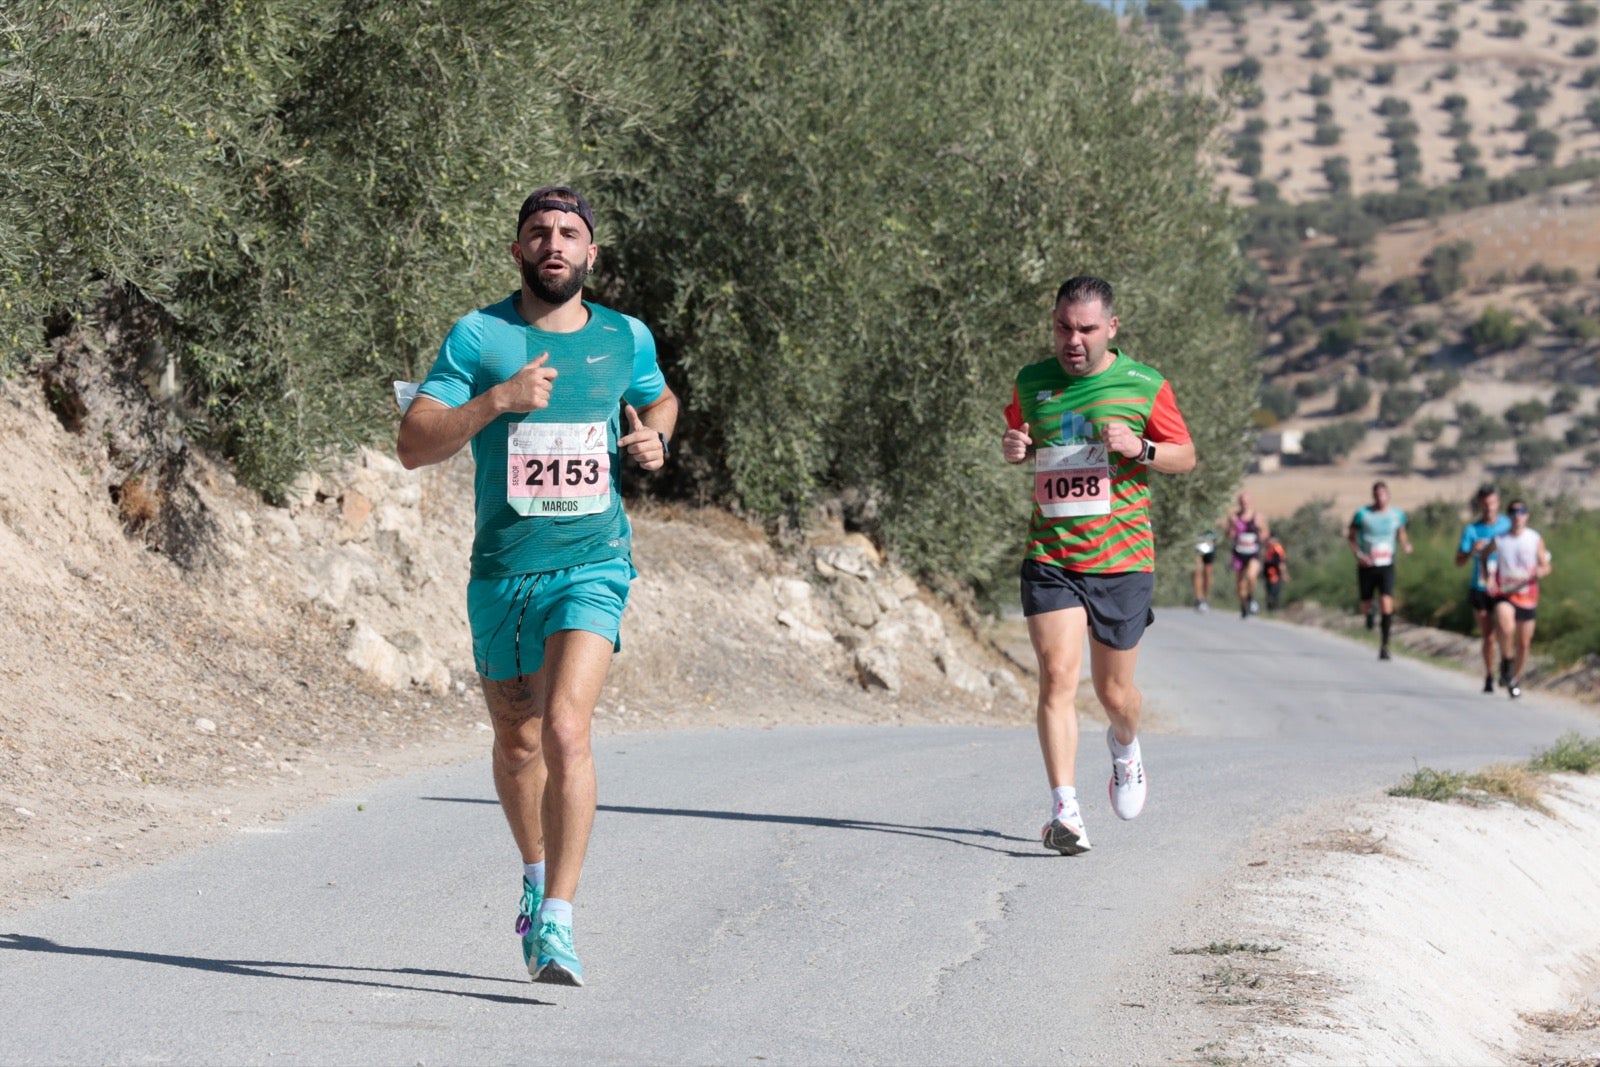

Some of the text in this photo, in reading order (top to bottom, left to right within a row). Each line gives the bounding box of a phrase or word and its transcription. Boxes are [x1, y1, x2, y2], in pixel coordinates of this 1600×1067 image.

[526, 459, 599, 486] 2153
[1043, 476, 1100, 499] 1058
[542, 500, 578, 512] MARCOS
